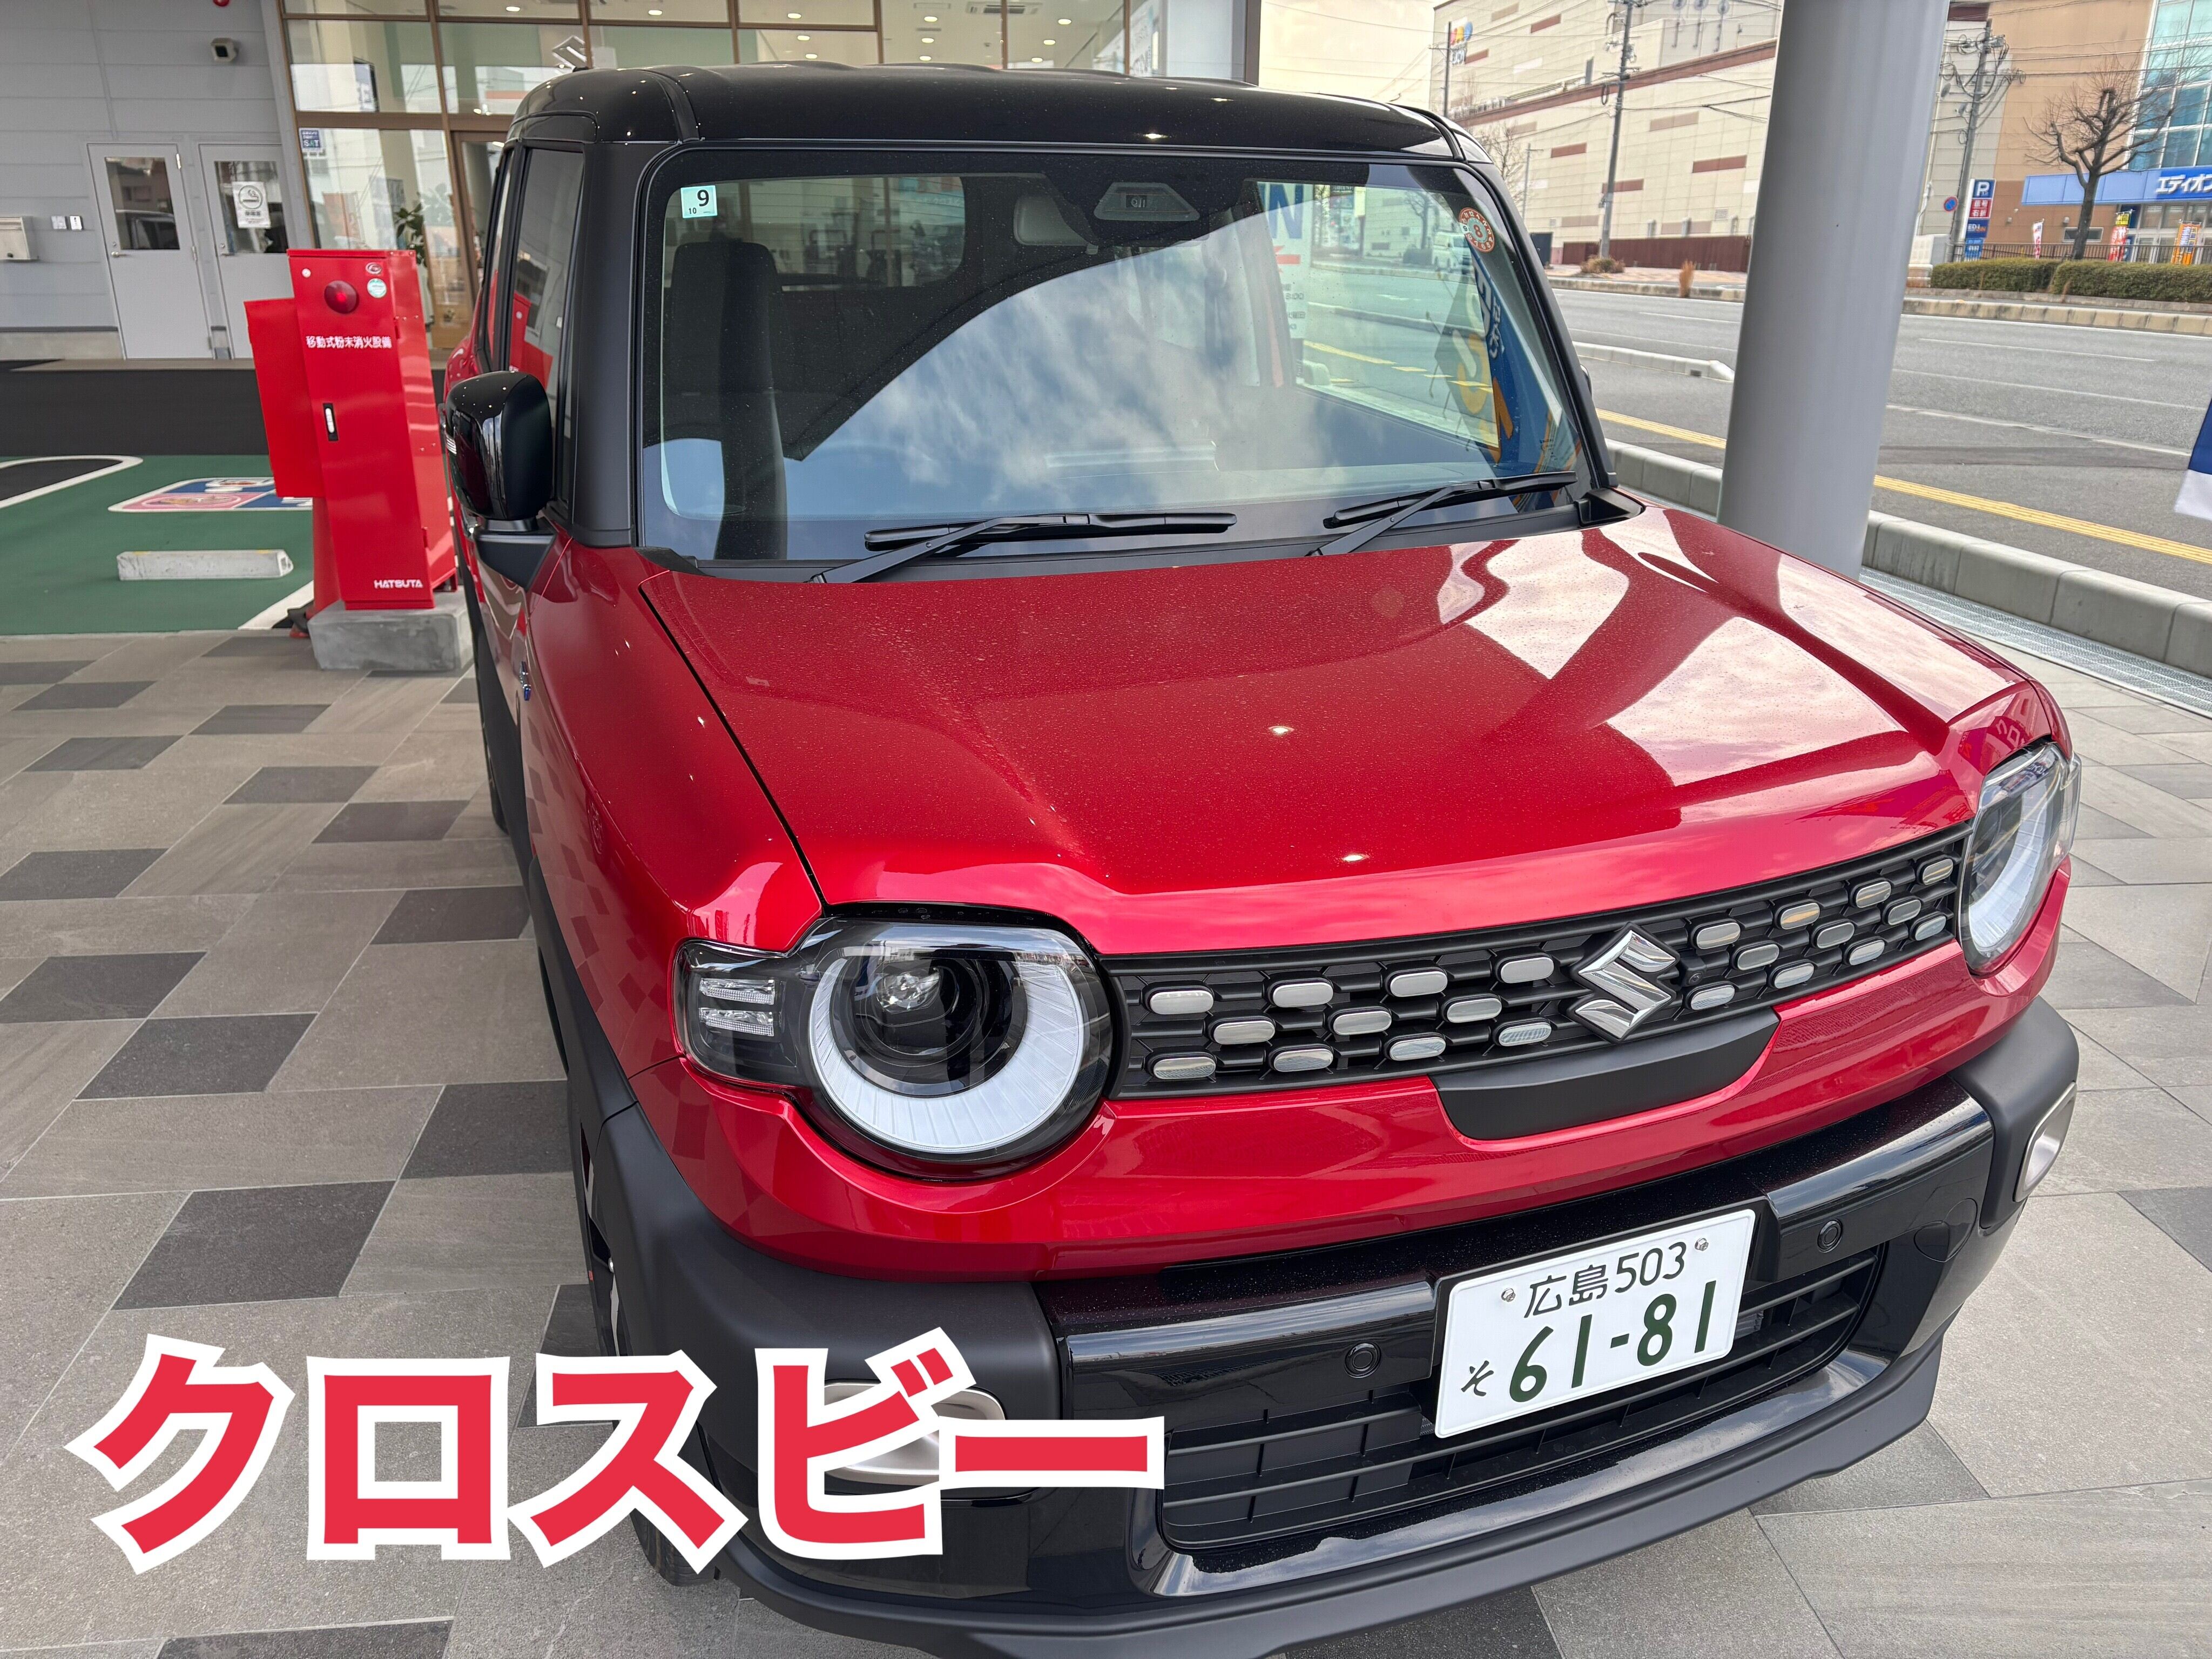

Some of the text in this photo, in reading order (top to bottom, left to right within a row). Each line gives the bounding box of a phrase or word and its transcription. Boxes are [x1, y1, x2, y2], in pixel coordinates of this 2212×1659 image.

[1977, 181, 1990, 196] P
[697, 190, 709, 206] 9
[1473, 224, 1483, 238] 8
[306, 335, 392, 349] 移動式粉末消火設備
[374, 579, 423, 589] HATSUTA
[1461, 1280, 1716, 1402] そ 61-81
